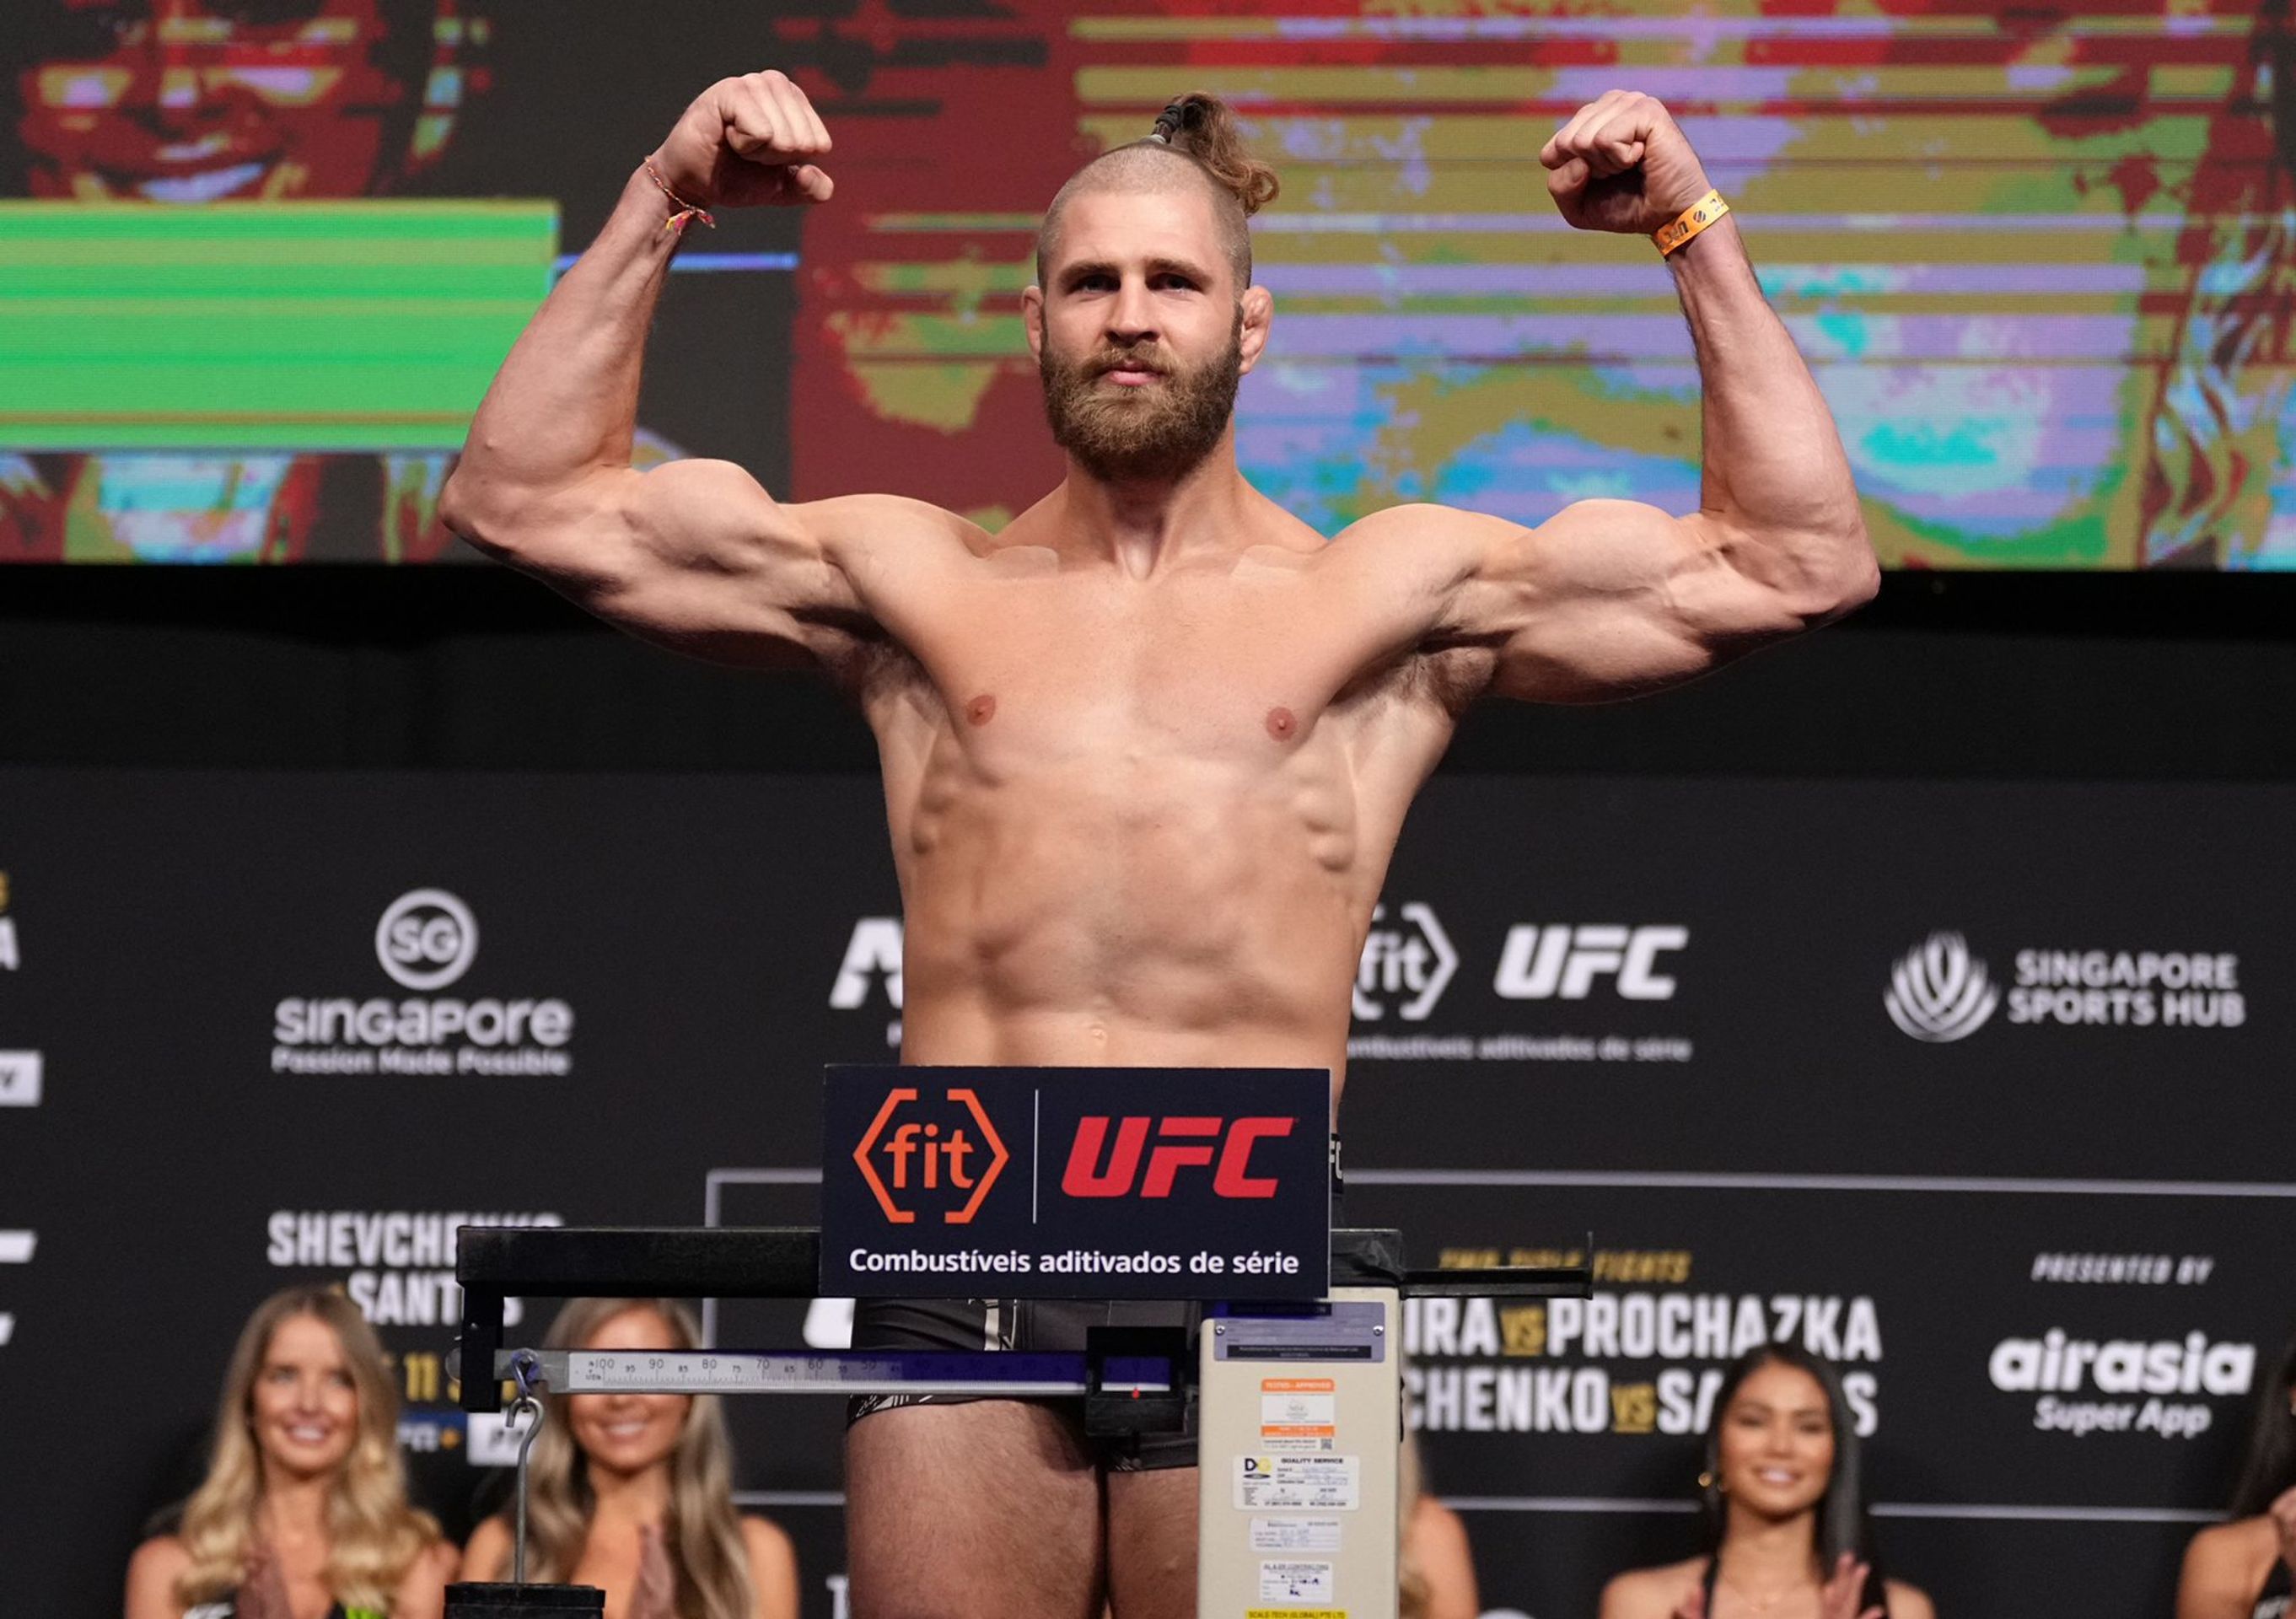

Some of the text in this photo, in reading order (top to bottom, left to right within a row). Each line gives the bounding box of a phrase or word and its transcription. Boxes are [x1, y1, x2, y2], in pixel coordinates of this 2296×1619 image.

[390, 917, 460, 963] SG
[1493, 924, 1688, 999] UFC
[2015, 949, 2239, 988] SINGAPORE
[2008, 987, 2246, 1027] SPORTS HUB
[883, 1116, 1294, 1198] fit UFC
[266, 1211, 562, 1266] SHEVCH
[849, 1248, 1299, 1274] Combustíveis aditivados de série
[2031, 1253, 2214, 1284] PRESENTED BY
[1546, 1294, 1883, 1361] PROCHAZKA
[648, 1358, 664, 1369] 90
[702, 1359, 717, 1369] 80
[808, 1359, 824, 1370] 60
[1988, 1327, 2256, 1395] airasia
[2033, 1396, 2212, 1439] Super App
